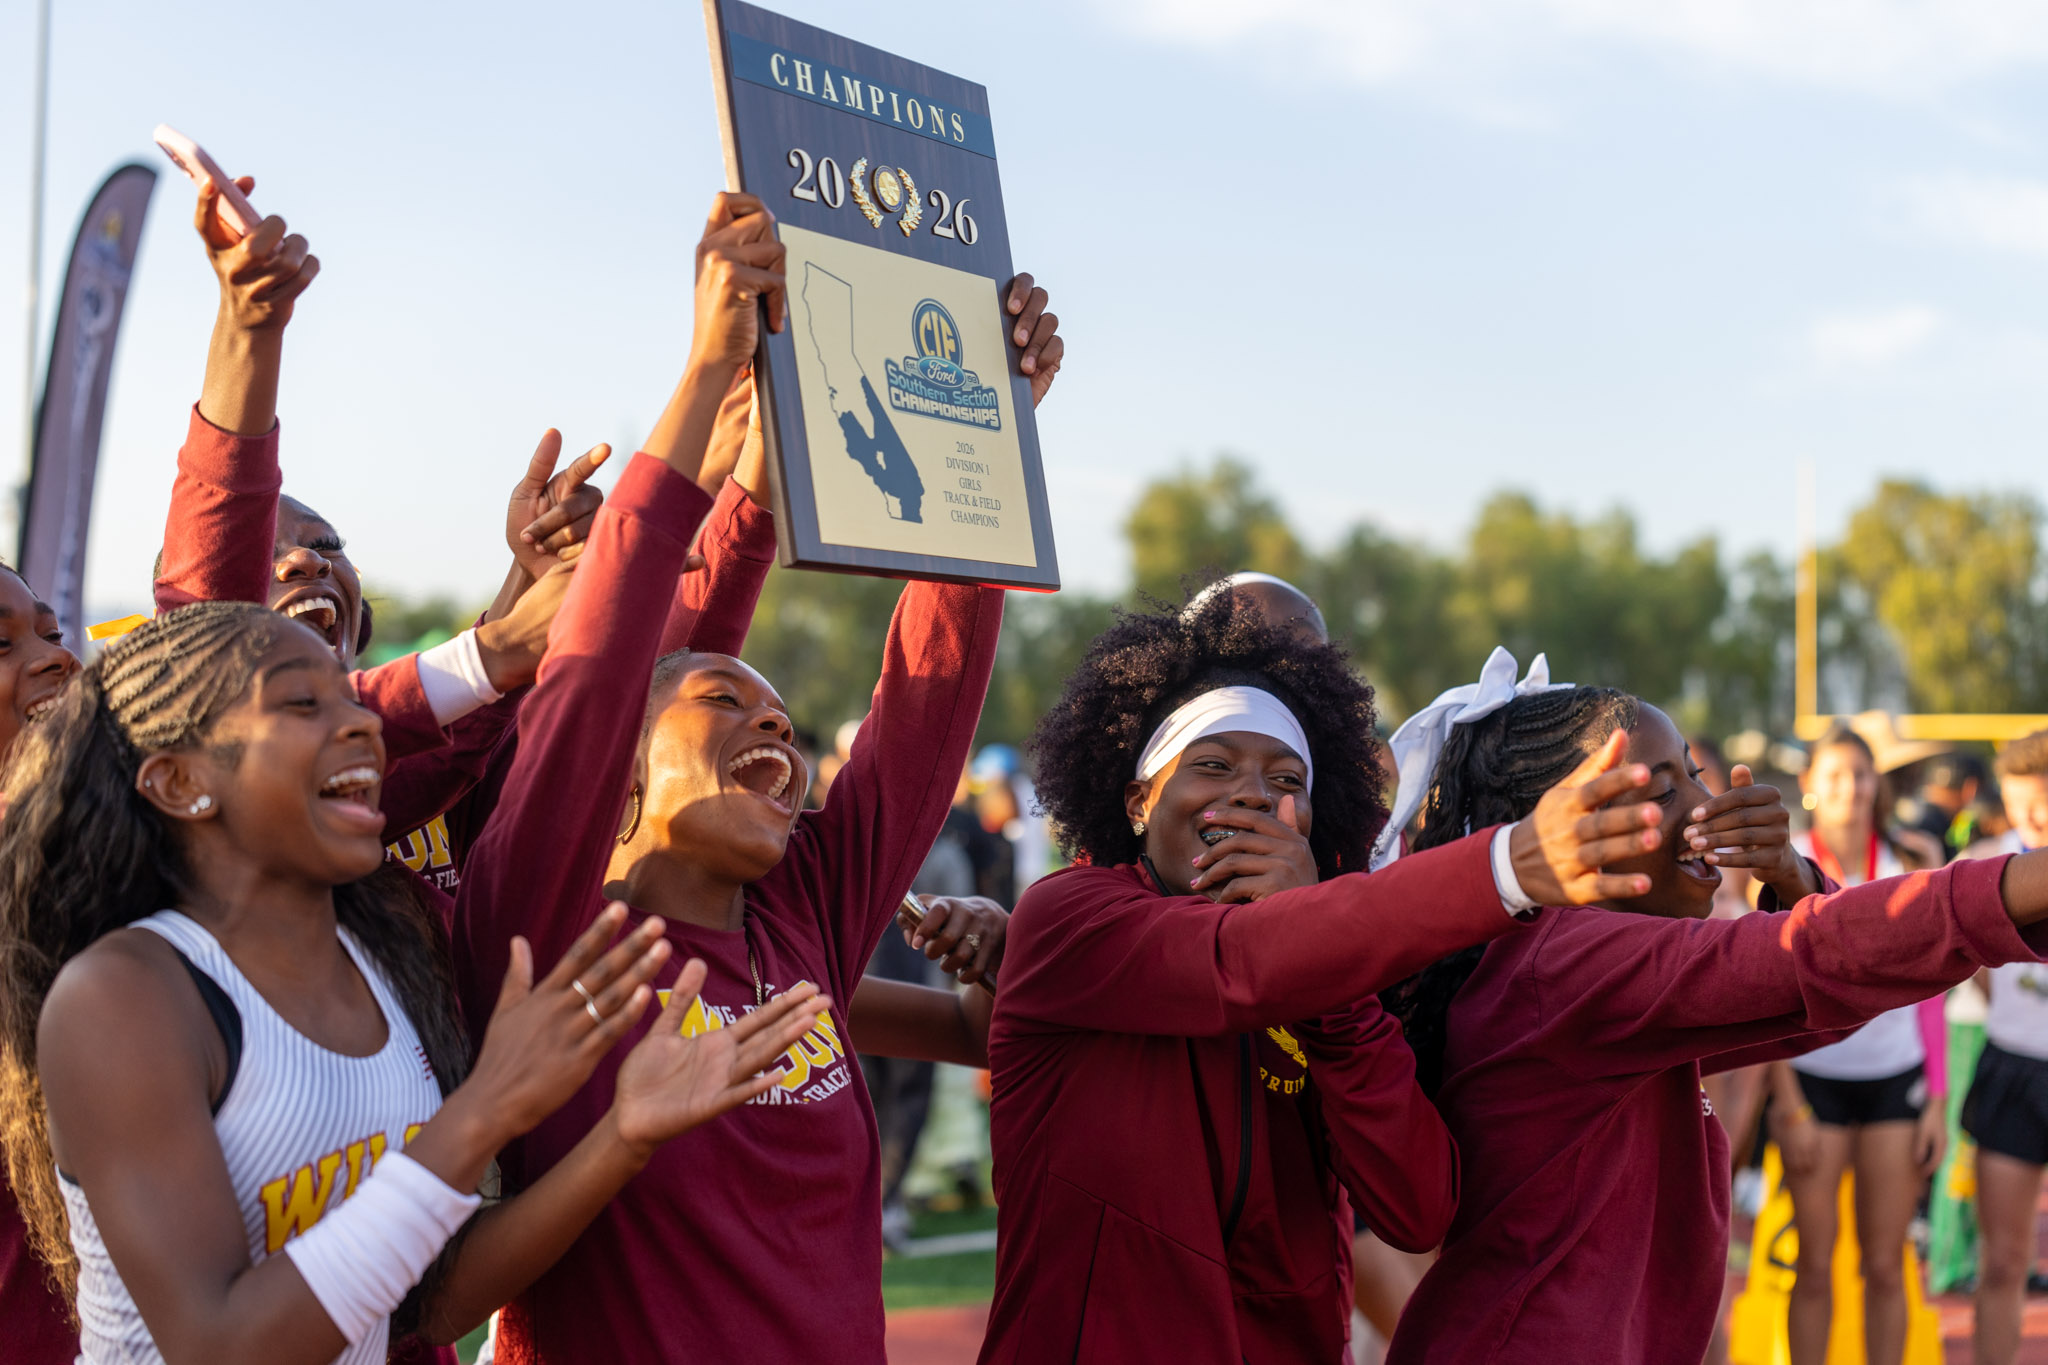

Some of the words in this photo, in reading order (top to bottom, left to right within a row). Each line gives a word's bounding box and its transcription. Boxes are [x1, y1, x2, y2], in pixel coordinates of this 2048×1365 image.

[769, 52, 965, 143] CHAMPIONS
[788, 148, 845, 209] 20
[929, 189, 979, 246] 26
[918, 310, 956, 361] CIF
[887, 363, 948, 403] Southern
[952, 390, 997, 407] Section
[927, 360, 957, 385] Ford
[890, 385, 1000, 428] CHAMPIONSHIPS
[956, 441, 975, 455] 2026
[945, 456, 984, 474] DIVISION
[959, 477, 981, 491] GIRLS
[943, 490, 970, 506] TRACK
[971, 495, 978, 507] &
[979, 496, 1001, 510] FIELD
[950, 509, 999, 528] CHAMPIONS
